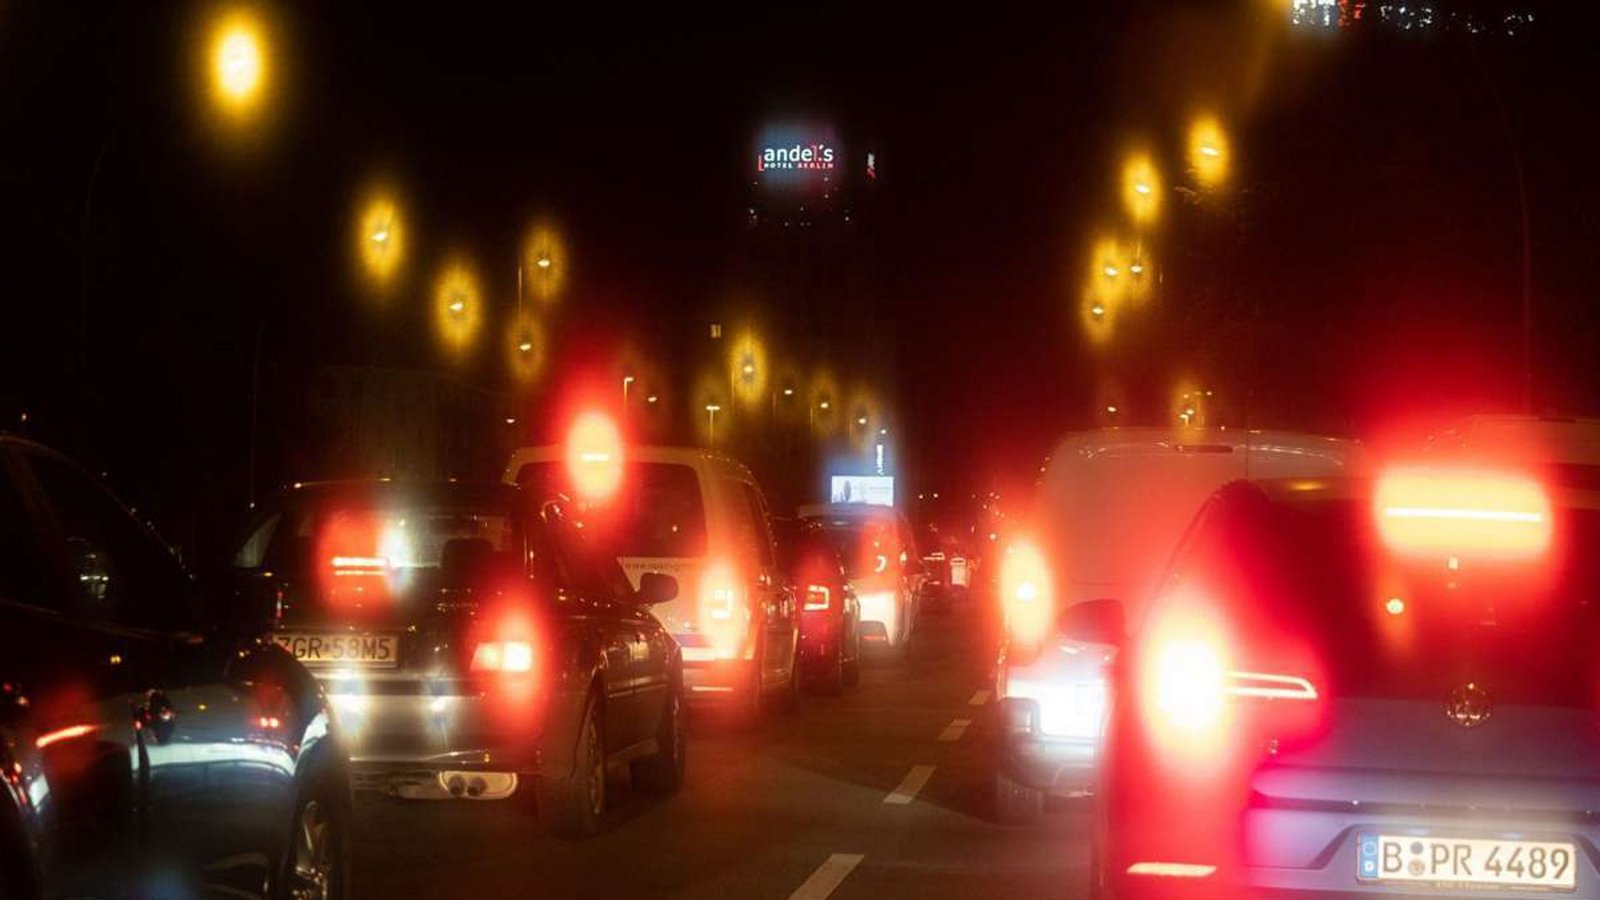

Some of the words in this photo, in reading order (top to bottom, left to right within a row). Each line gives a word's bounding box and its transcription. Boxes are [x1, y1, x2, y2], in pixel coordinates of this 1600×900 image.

[1382, 841, 1403, 873] B
[1430, 843, 1473, 876] PR
[1484, 845, 1570, 880] 4489
